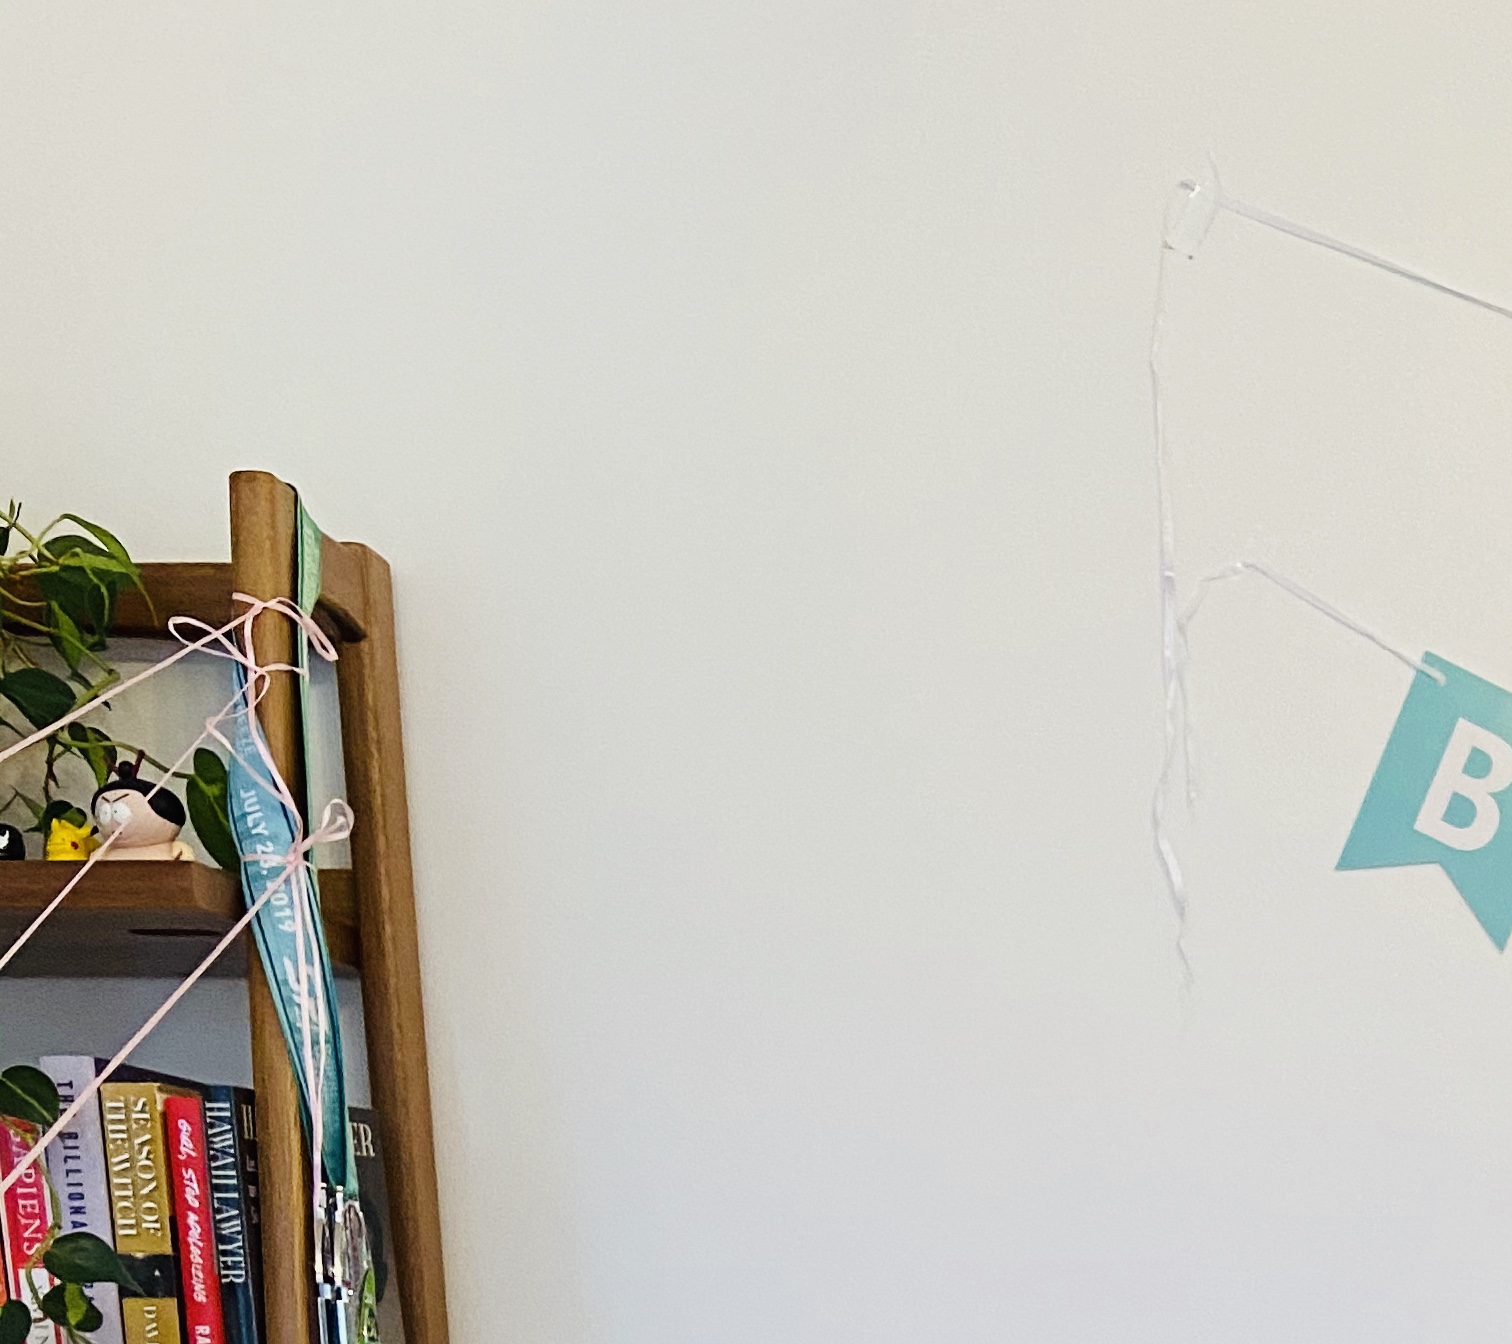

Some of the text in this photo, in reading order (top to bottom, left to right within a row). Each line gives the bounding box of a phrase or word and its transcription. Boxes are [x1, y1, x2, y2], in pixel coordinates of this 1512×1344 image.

[239, 787, 269, 837] JULY
[104, 1096, 138, 1236] THE WITCH
[131, 1097, 162, 1237] SEASON OF
[181, 1167, 201, 1208] STOP
[204, 1101, 247, 1284] HAWAII LAWYER
